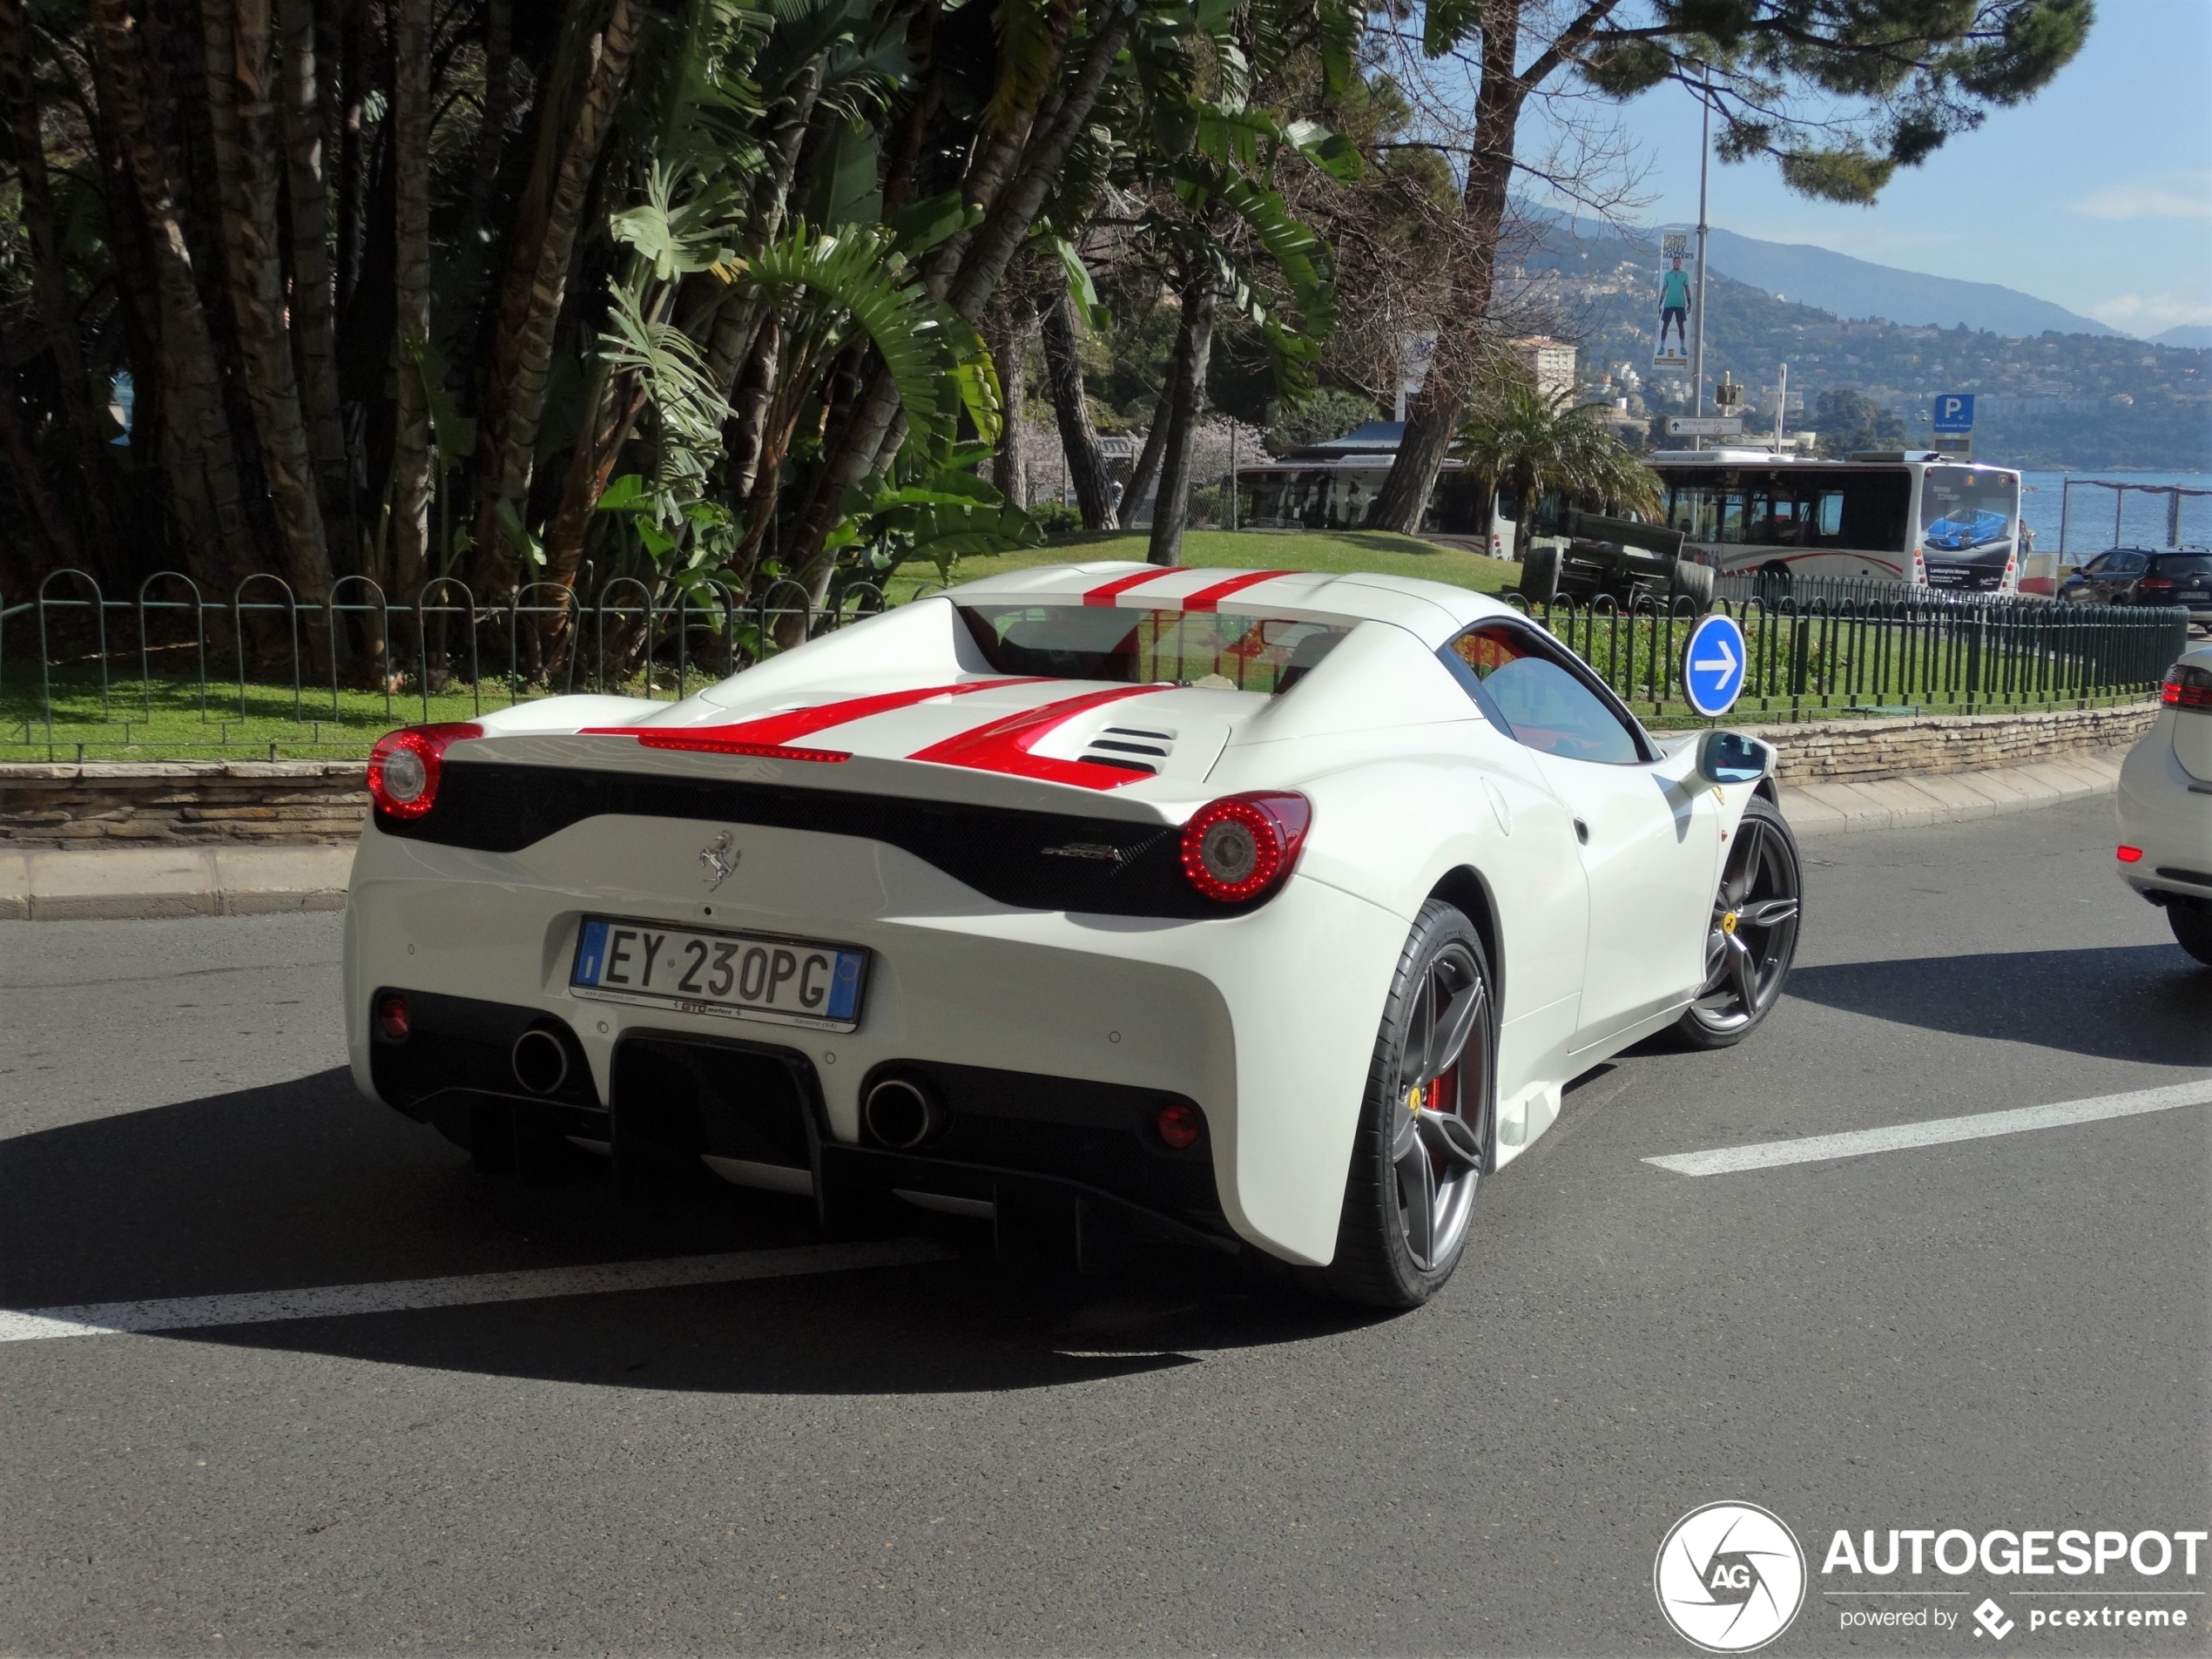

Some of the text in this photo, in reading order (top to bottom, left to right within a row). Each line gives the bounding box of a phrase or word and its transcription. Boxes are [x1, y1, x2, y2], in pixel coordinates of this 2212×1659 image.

[1945, 398, 1961, 419] P
[605, 929, 828, 1008] EY 230PG
[681, 1002, 732, 1016] GTO motors
[793, 1017, 838, 1030] Saronno (VA)
